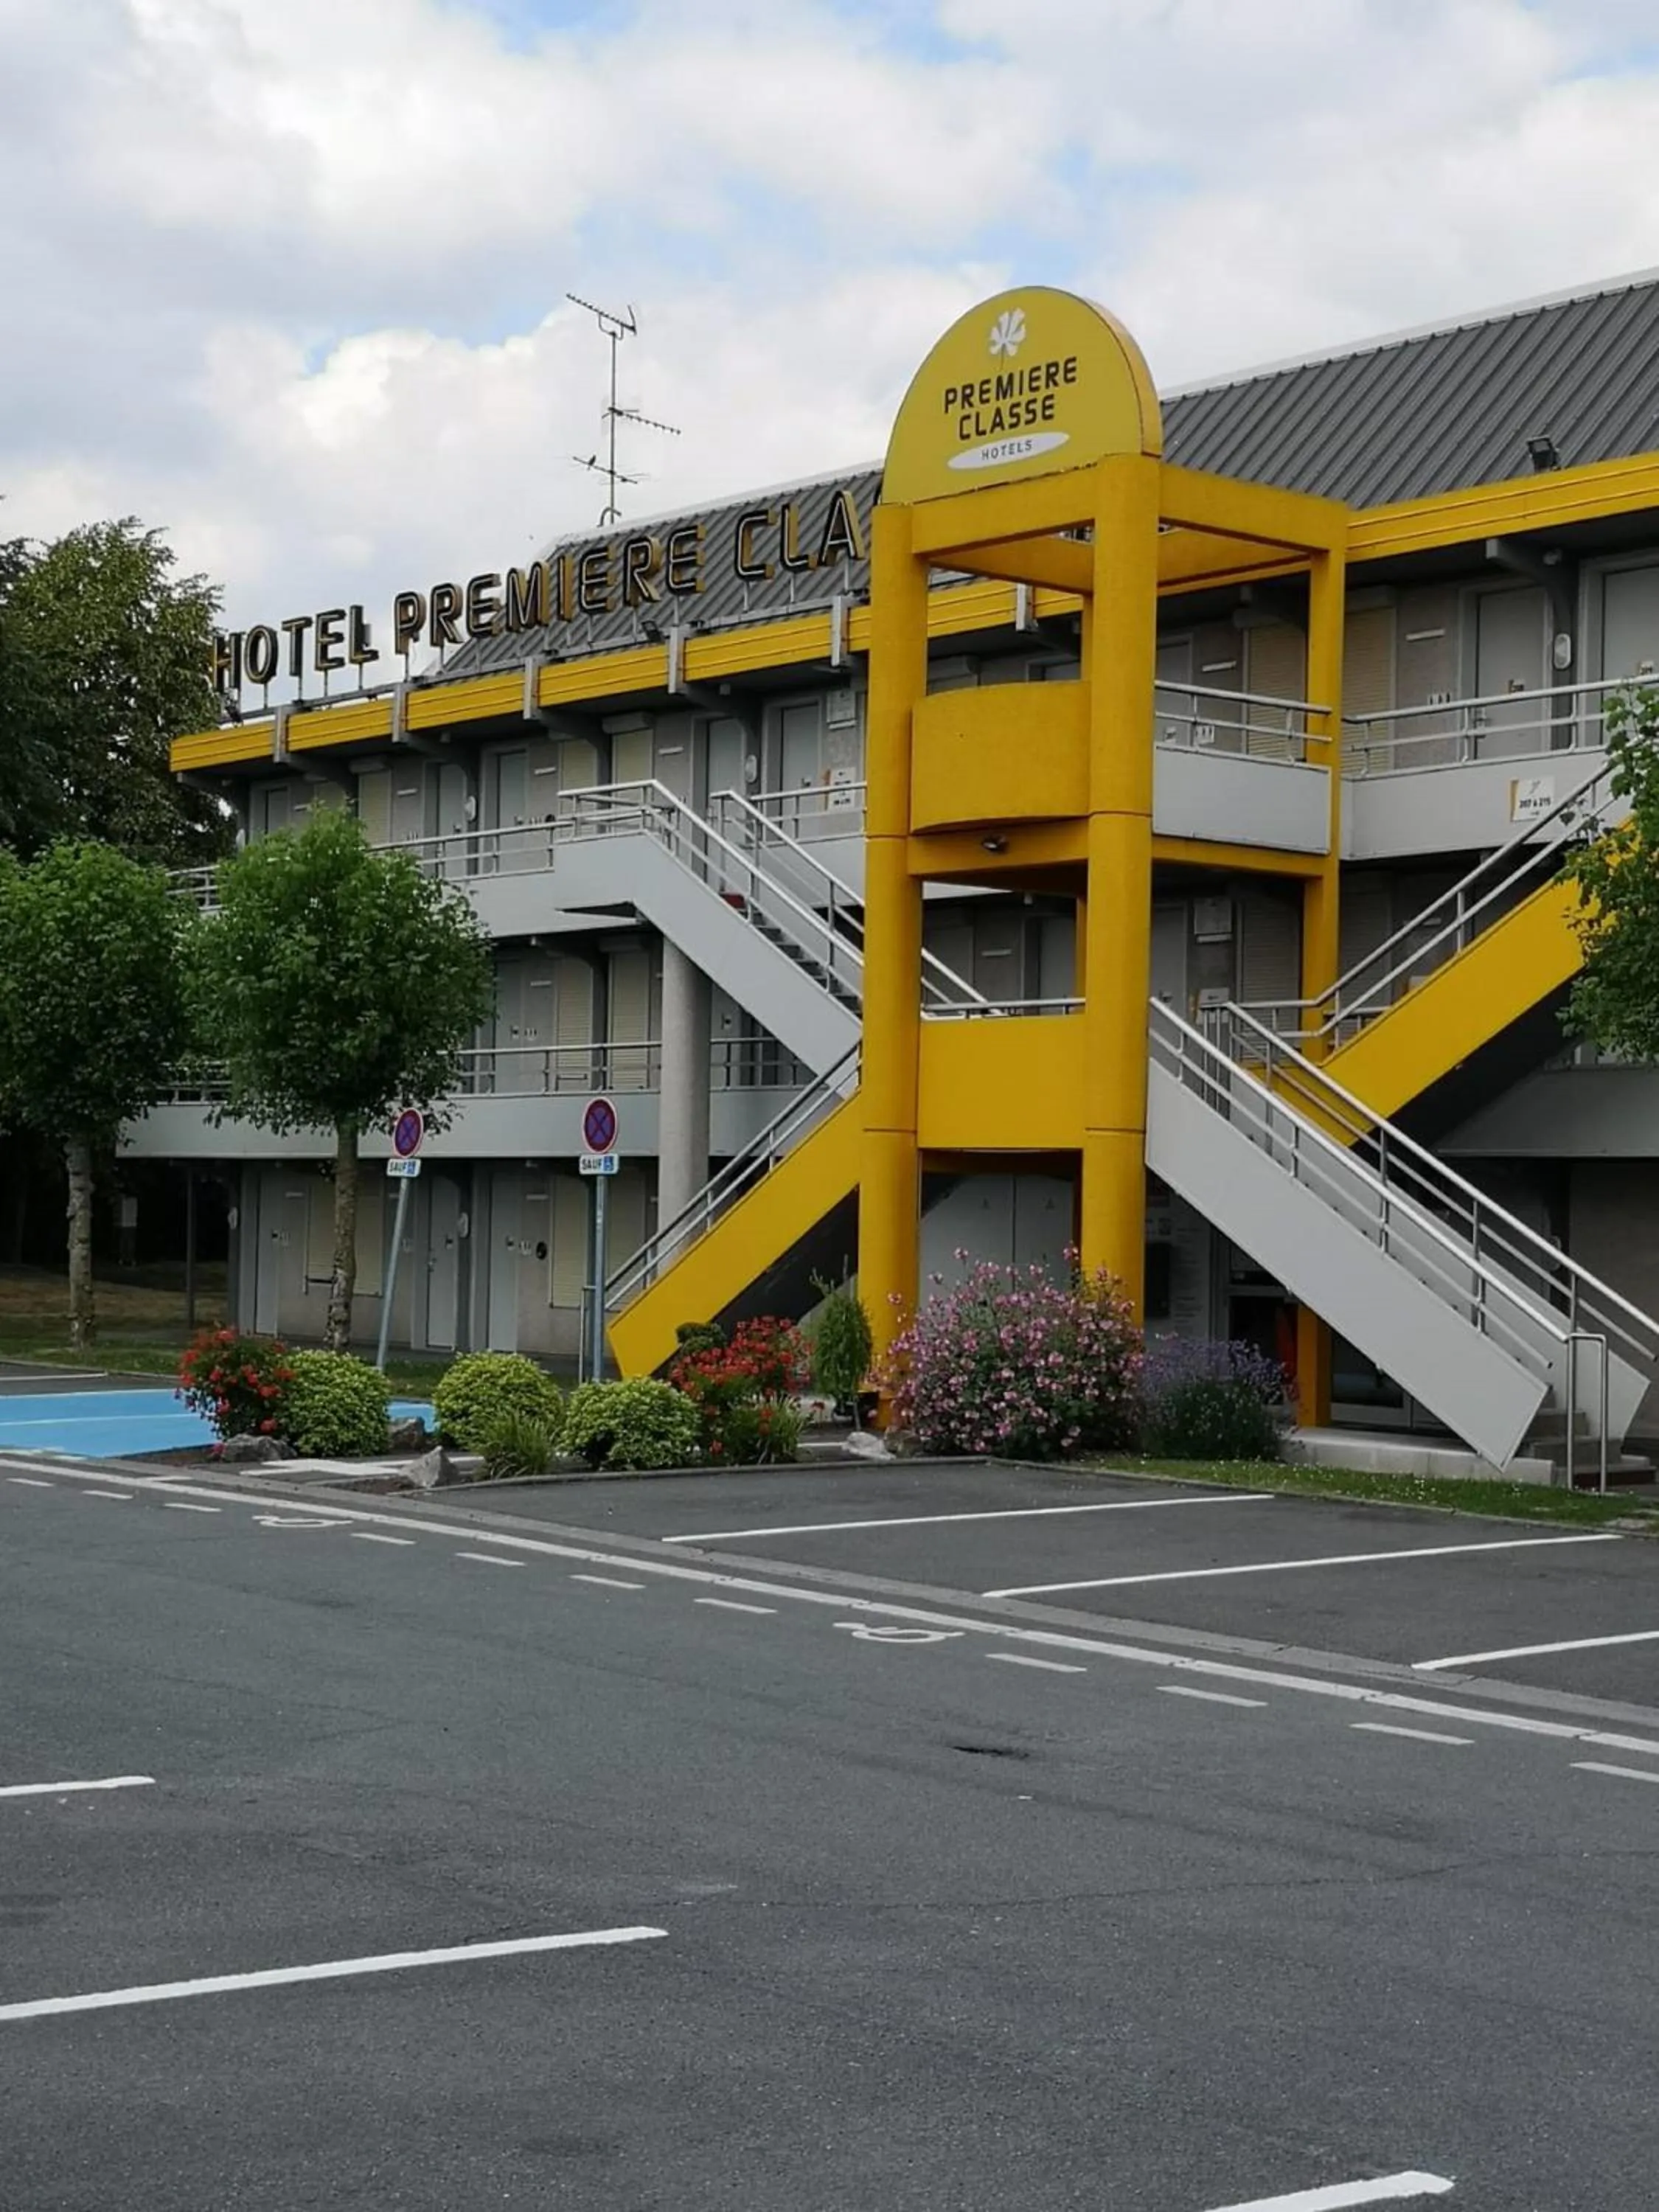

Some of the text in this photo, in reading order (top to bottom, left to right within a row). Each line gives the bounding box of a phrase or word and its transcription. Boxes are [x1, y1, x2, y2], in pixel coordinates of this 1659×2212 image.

[944, 356, 1078, 414] PREMIERE
[959, 394, 1055, 441] CLASSE
[981, 440, 1032, 461] HOTELS
[212, 490, 867, 692] HOTEL PREMIERE CLA
[389, 1161, 408, 1173] SAUF
[582, 1158, 602, 1171] SAUF
